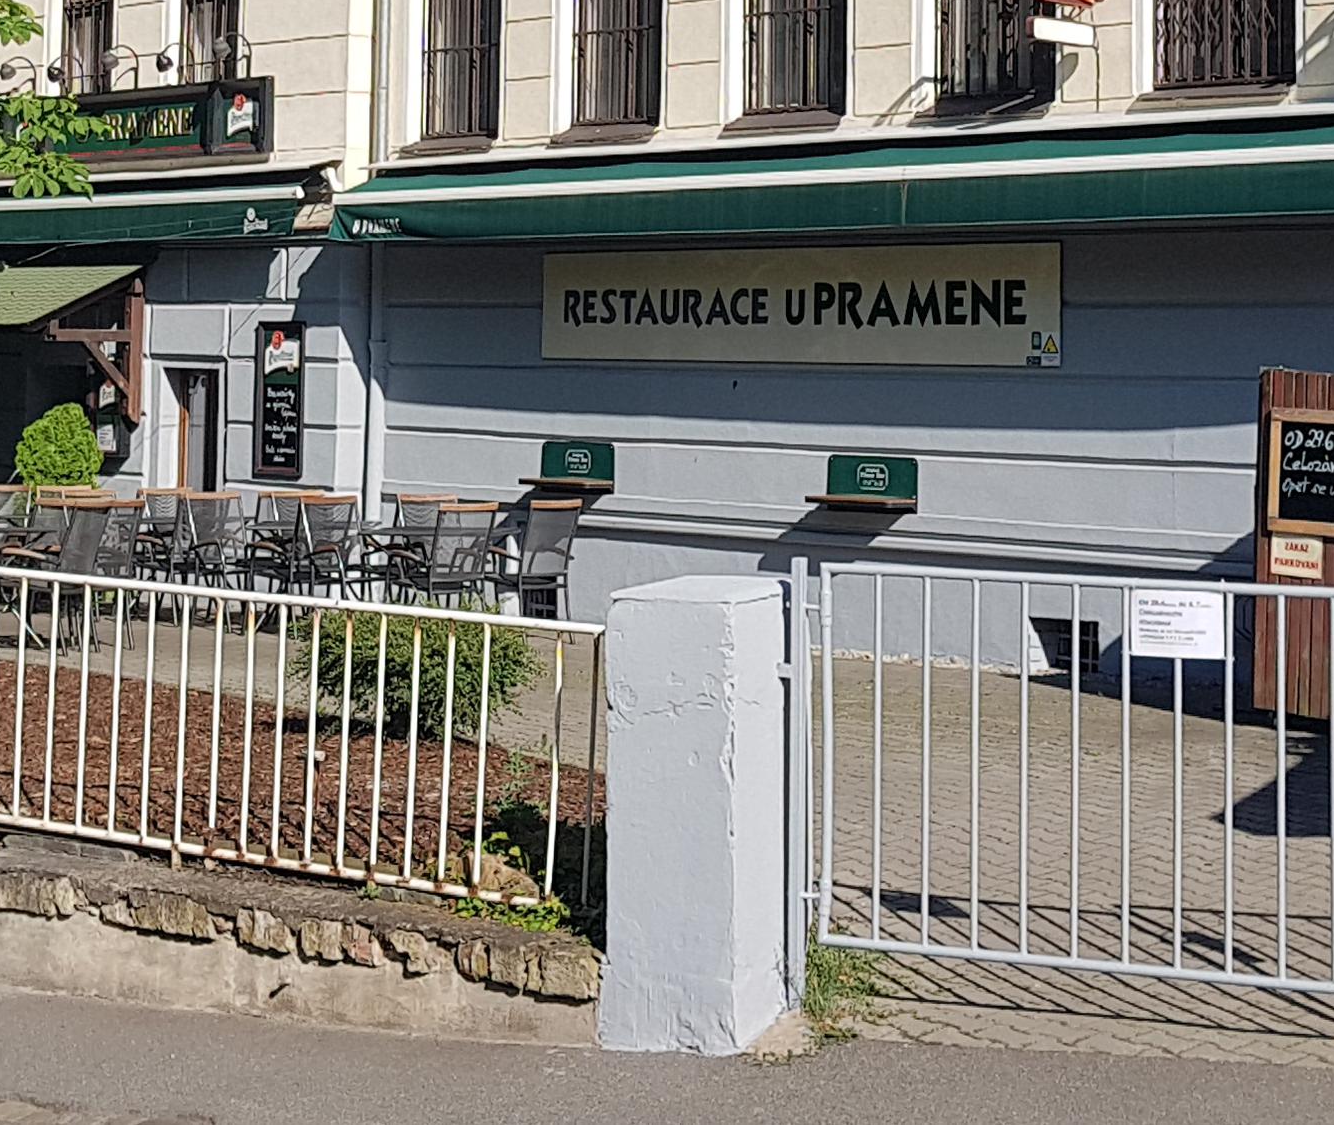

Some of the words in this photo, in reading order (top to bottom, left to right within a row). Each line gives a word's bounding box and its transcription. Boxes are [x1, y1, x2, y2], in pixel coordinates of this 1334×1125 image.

[563, 286, 769, 328] RESTAURACE
[785, 289, 806, 326] U
[813, 279, 1028, 330] PRAMENE
[1284, 430, 1304, 450] OD
